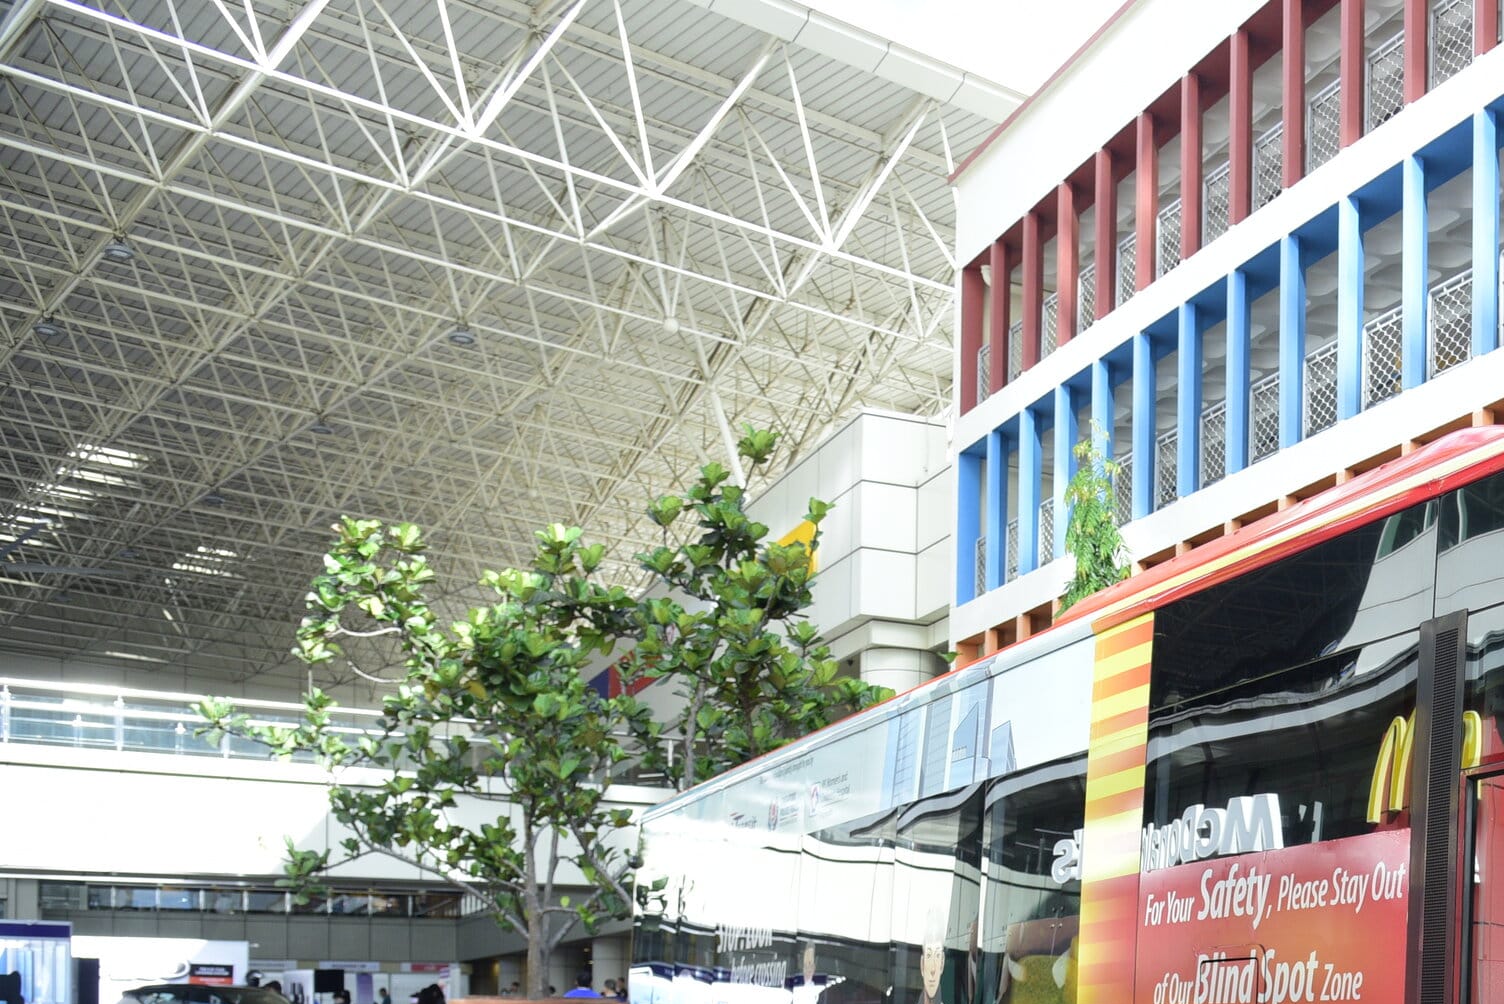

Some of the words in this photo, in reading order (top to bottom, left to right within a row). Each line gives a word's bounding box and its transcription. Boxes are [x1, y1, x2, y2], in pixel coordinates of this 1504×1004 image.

[1144, 894, 1166, 927] For
[1165, 890, 1195, 925] Your
[1197, 863, 1272, 930] Safety,
[1277, 873, 1328, 912] Please
[1330, 867, 1369, 914] Stay
[1371, 861, 1406, 901] Out
[1319, 963, 1364, 1002] Zone
